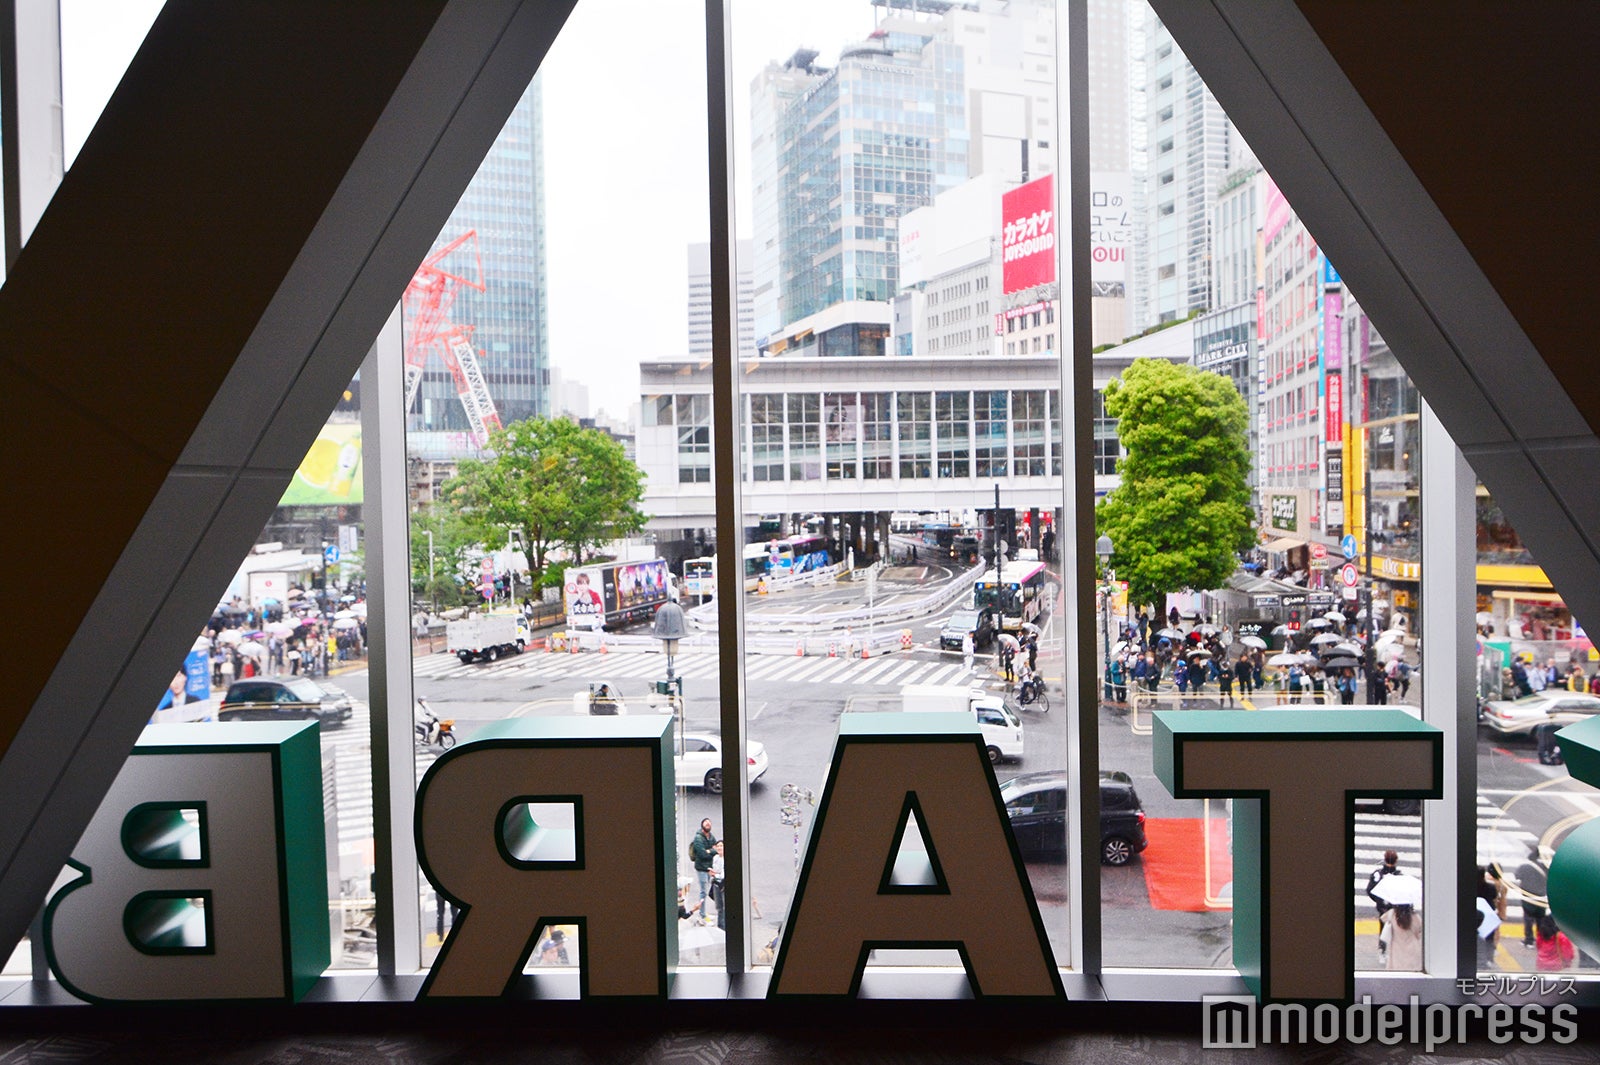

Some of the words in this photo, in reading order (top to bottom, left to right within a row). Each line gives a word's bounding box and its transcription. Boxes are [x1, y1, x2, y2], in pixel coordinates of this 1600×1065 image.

[1004, 209, 1053, 246] カラオケ
[1004, 232, 1054, 263] JOYSOUND
[1198, 350, 1222, 363] MARK
[1225, 343, 1248, 356] CITY
